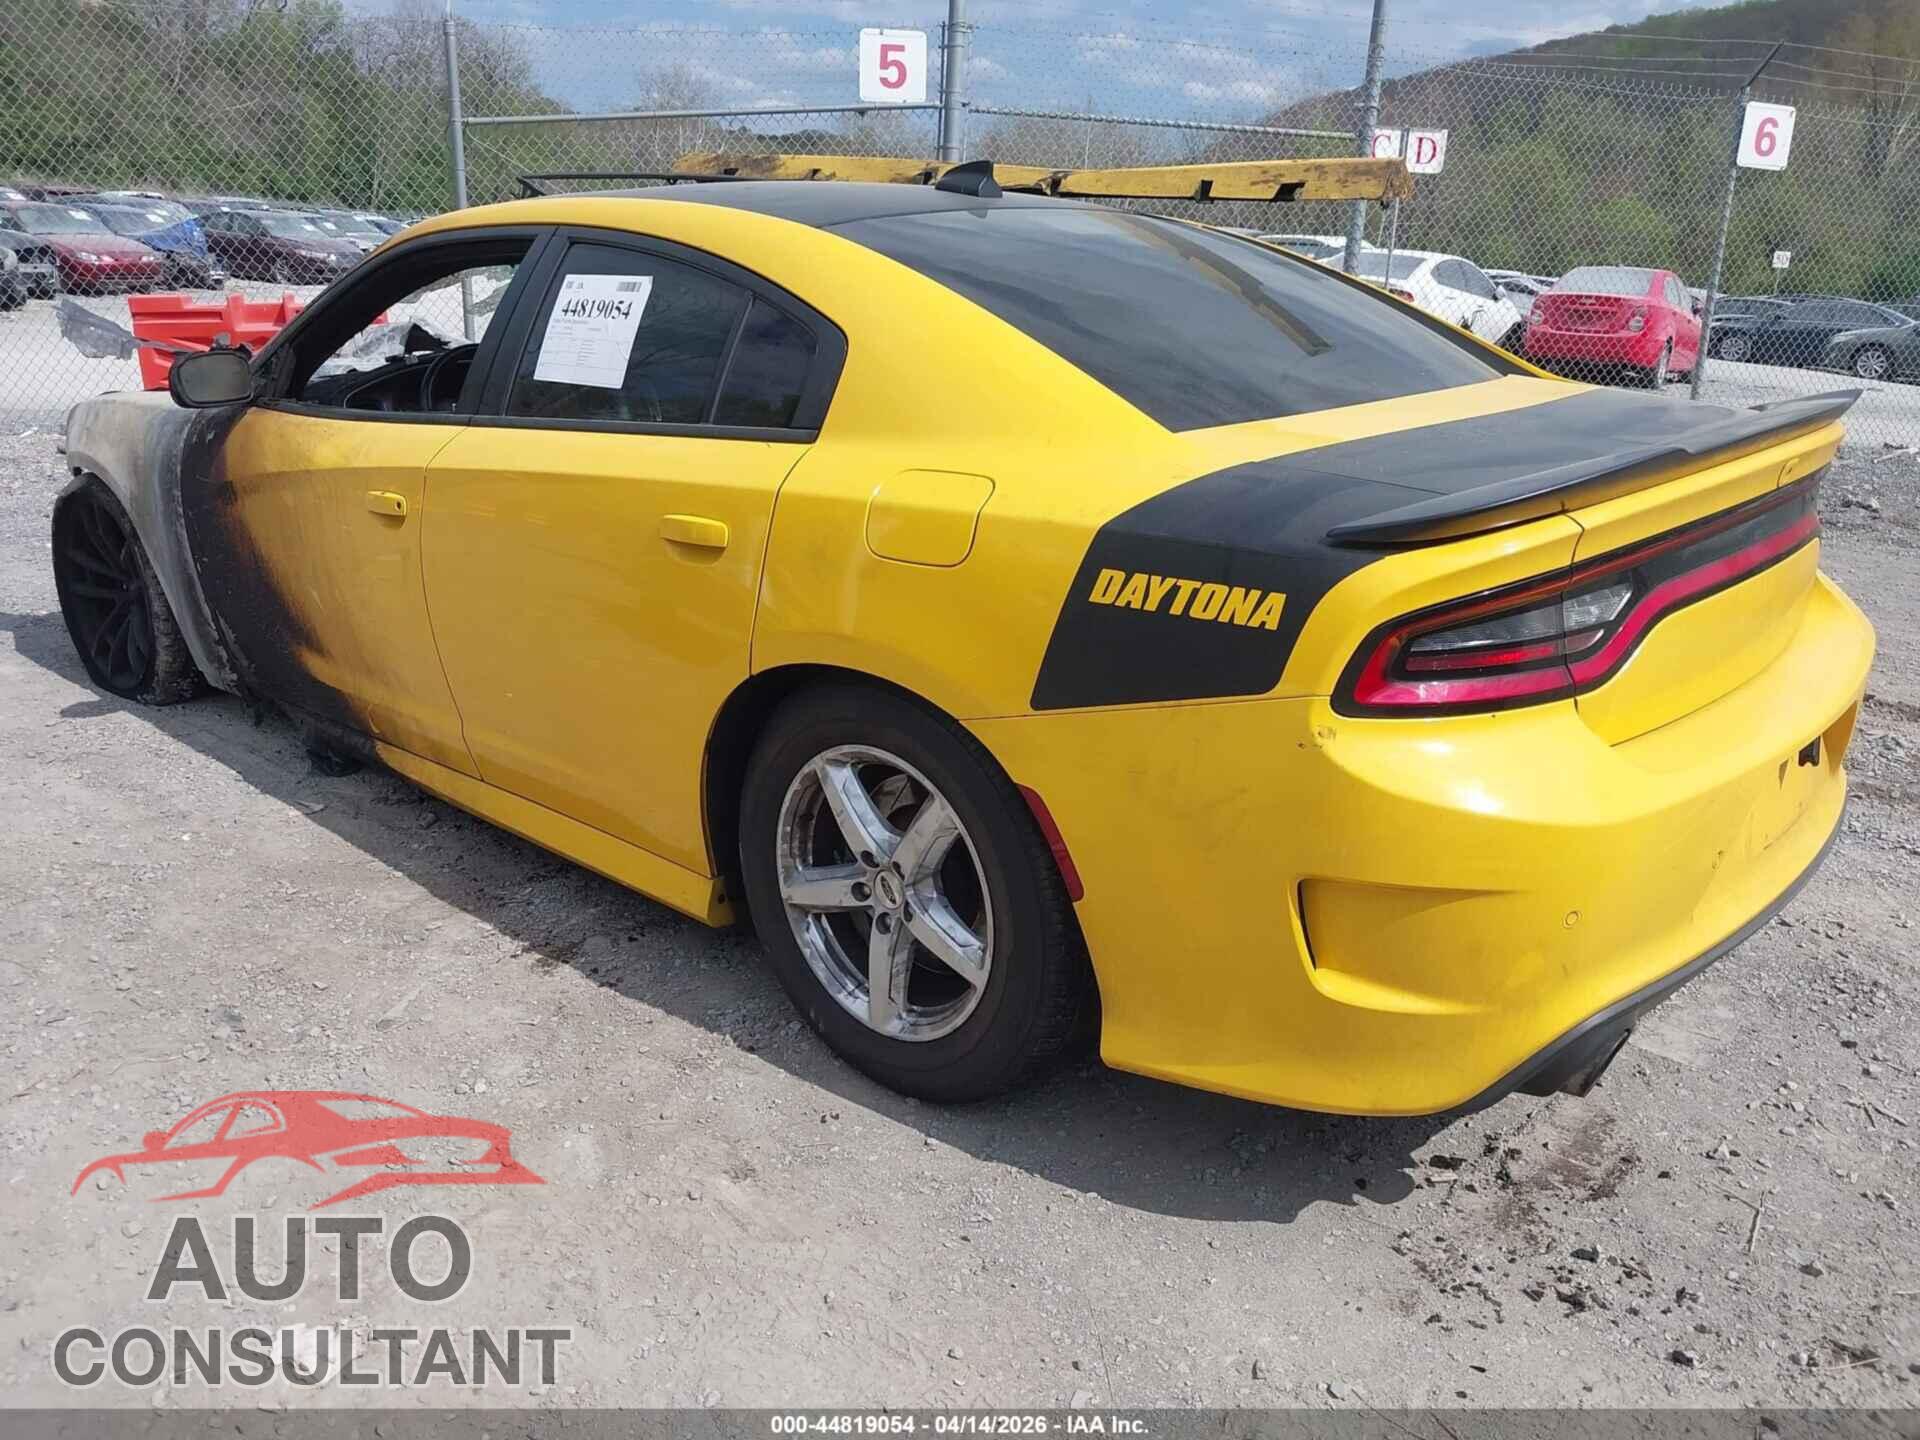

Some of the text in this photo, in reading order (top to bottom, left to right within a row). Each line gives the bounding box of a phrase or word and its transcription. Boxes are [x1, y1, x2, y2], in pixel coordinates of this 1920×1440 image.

[879, 44, 907, 89] 5
[1415, 137, 1437, 164] D
[1755, 117, 1779, 157] 6
[561, 298, 632, 320] 44819054
[1088, 567, 1287, 631] DAYTONA
